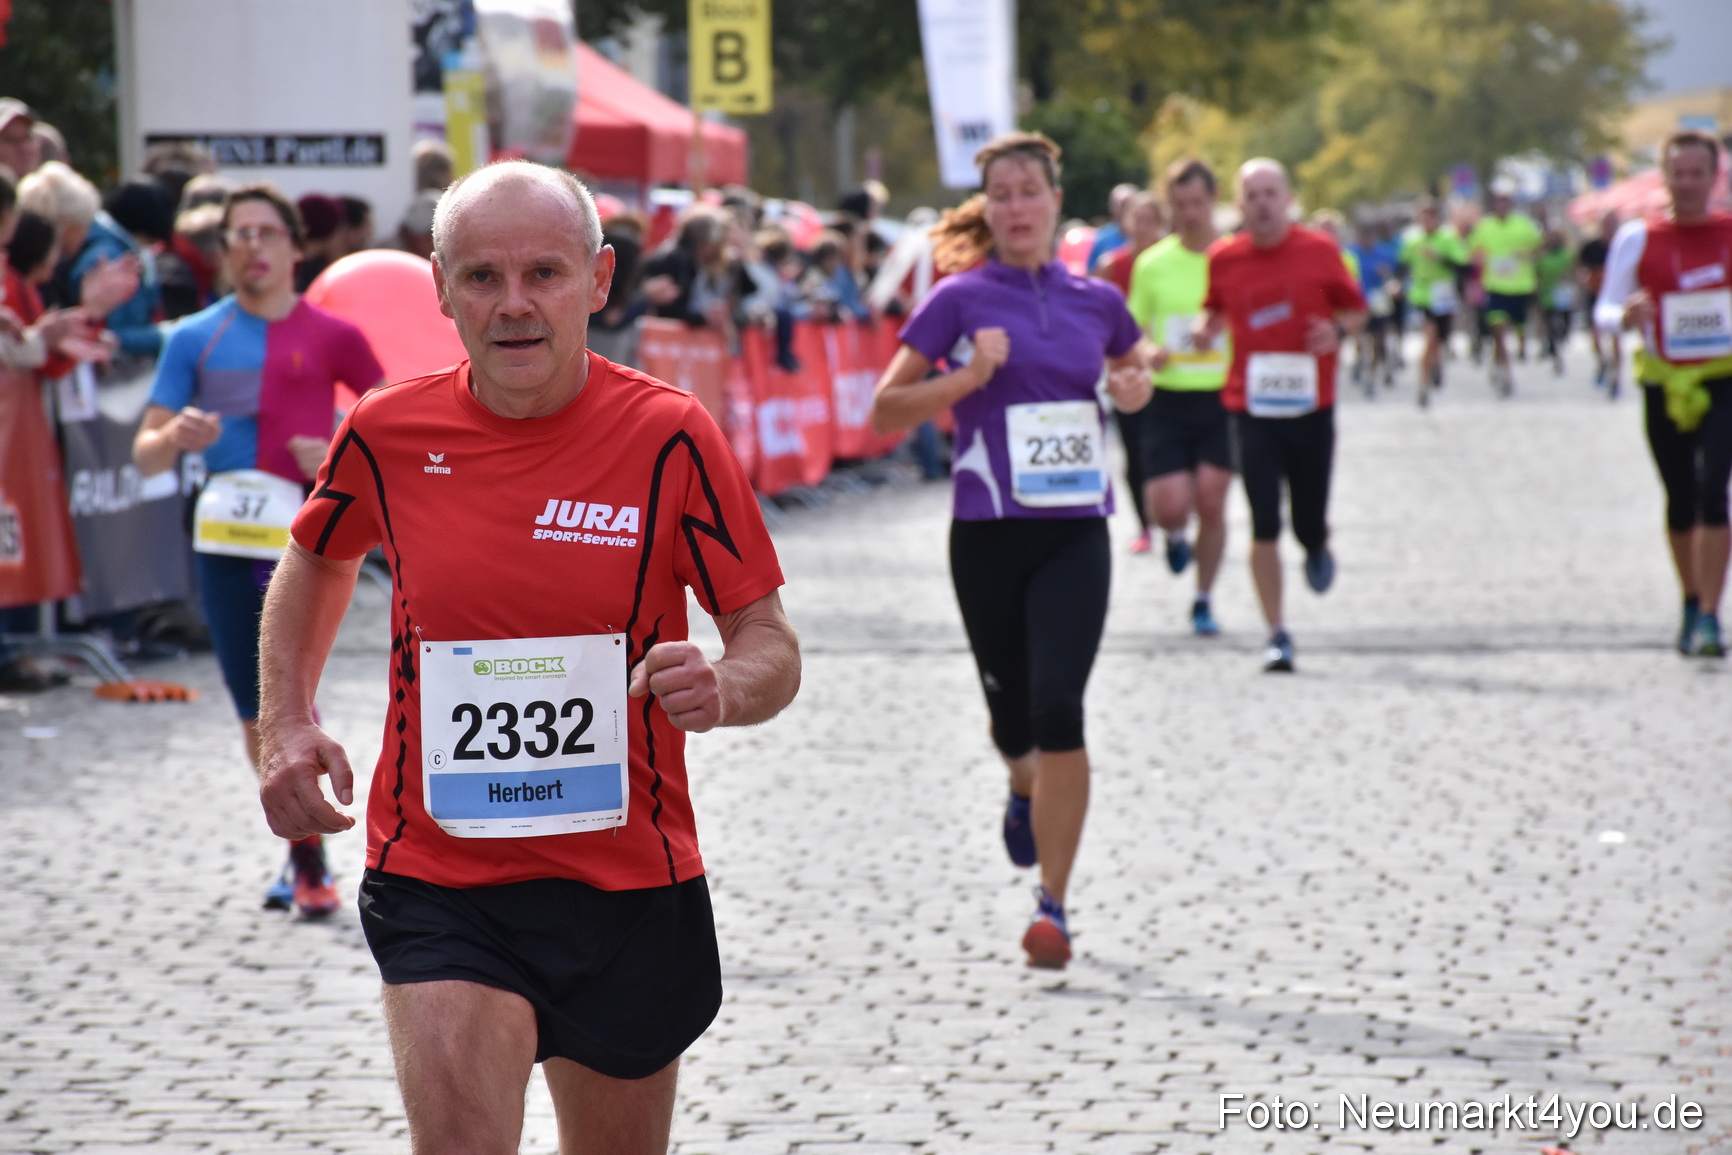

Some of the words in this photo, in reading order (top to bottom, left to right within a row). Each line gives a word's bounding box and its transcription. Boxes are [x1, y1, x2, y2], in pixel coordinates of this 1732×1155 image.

[713, 31, 747, 83] B
[1026, 434, 1094, 466] 2336
[424, 464, 451, 475] erima
[232, 494, 269, 520] 37
[534, 498, 640, 534] JURA
[532, 528, 637, 548] SPORT-Service
[494, 656, 566, 675] BOCK
[452, 697, 595, 761] 2332
[434, 754, 441, 765] C
[488, 779, 564, 804] Herbert
